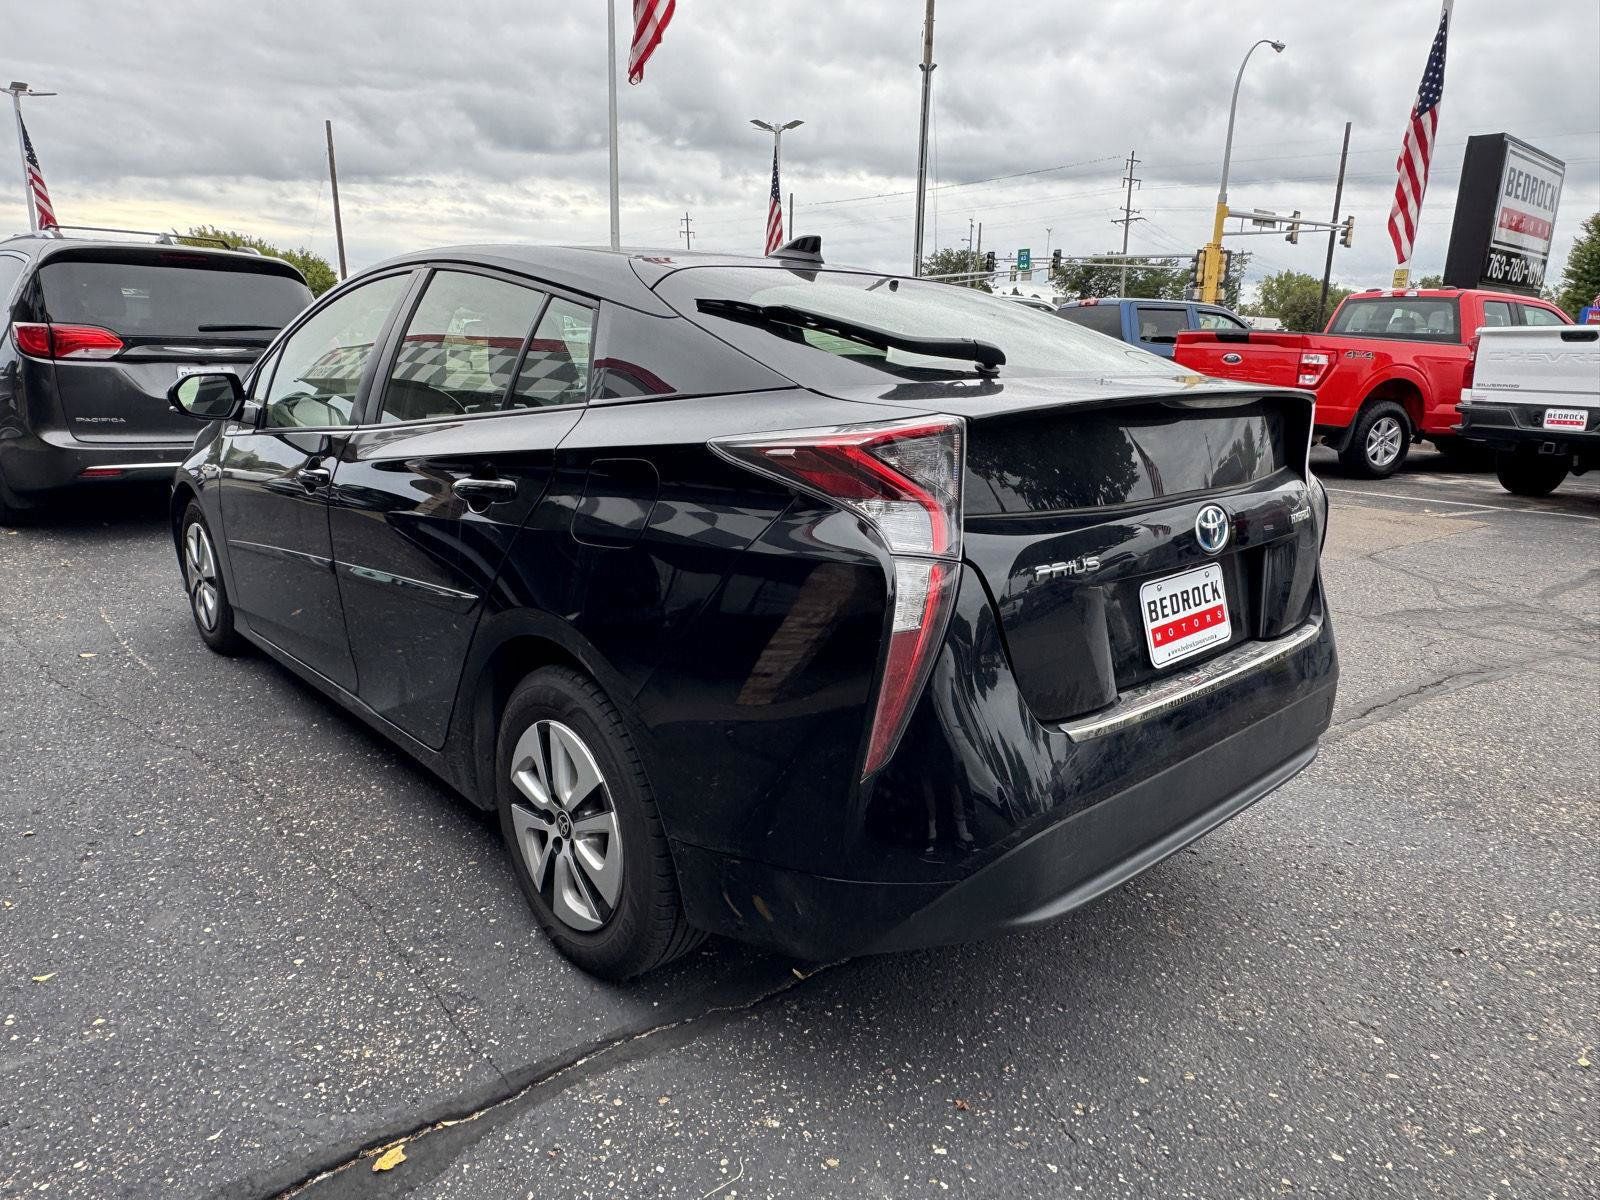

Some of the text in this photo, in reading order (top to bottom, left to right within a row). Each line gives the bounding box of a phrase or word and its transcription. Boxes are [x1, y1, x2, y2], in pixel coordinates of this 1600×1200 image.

[1505, 167, 1557, 212] BEDROCK
[1547, 412, 1585, 421] BEDROCK
[1034, 556, 1101, 582] PRIUS
[1146, 580, 1222, 623] BEDROCK
[1155, 610, 1223, 642] MOTORS
